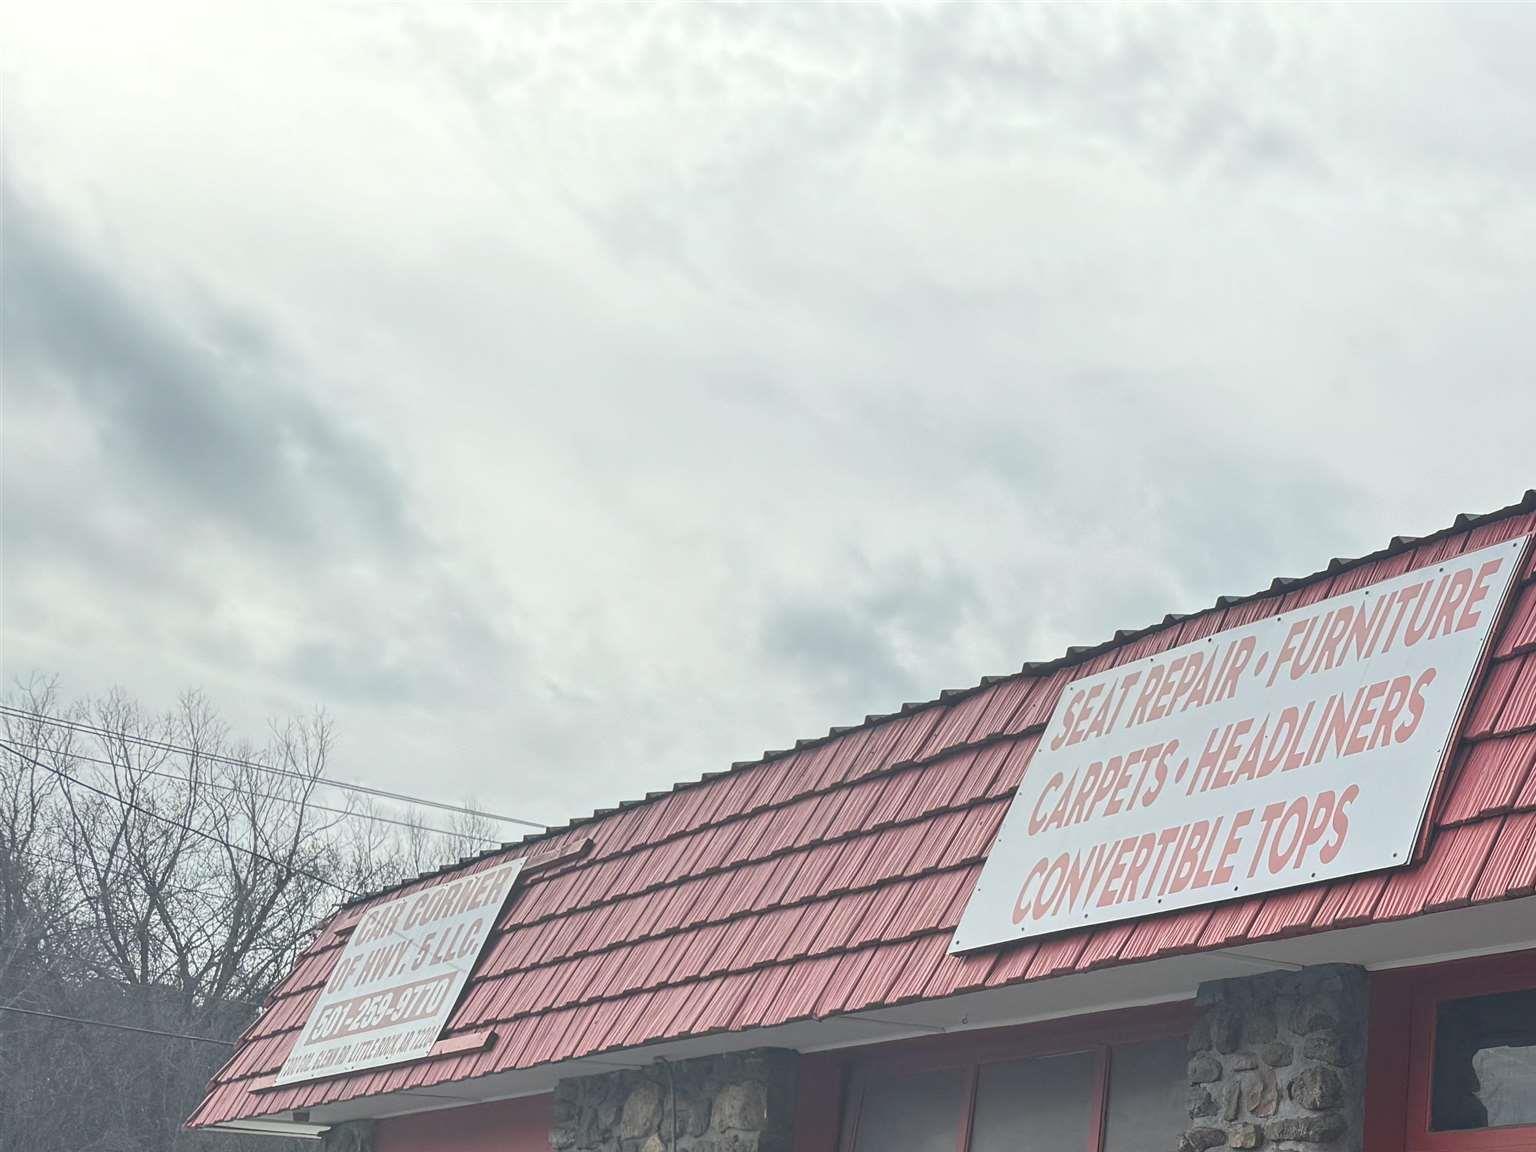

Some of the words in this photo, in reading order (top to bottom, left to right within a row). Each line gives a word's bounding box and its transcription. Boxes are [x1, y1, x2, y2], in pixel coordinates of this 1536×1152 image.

[1051, 671, 1142, 752] SEAT
[1125, 635, 1257, 729] REPAIR
[1265, 557, 1504, 688] FURNITURE
[1028, 738, 1179, 838] CARPETS
[1186, 667, 1436, 796] HEADLINERS
[355, 901, 403, 946] CAR
[403, 865, 513, 931] CORNER
[1012, 808, 1255, 925] CONVERTIBLE
[1247, 784, 1360, 879] TOPS
[311, 978, 449, 1040] 501-259-9770
[327, 954, 362, 994] OF
[355, 938, 412, 988] HWY.
[411, 931, 437, 972] 5
[429, 917, 484, 967] LLC.
